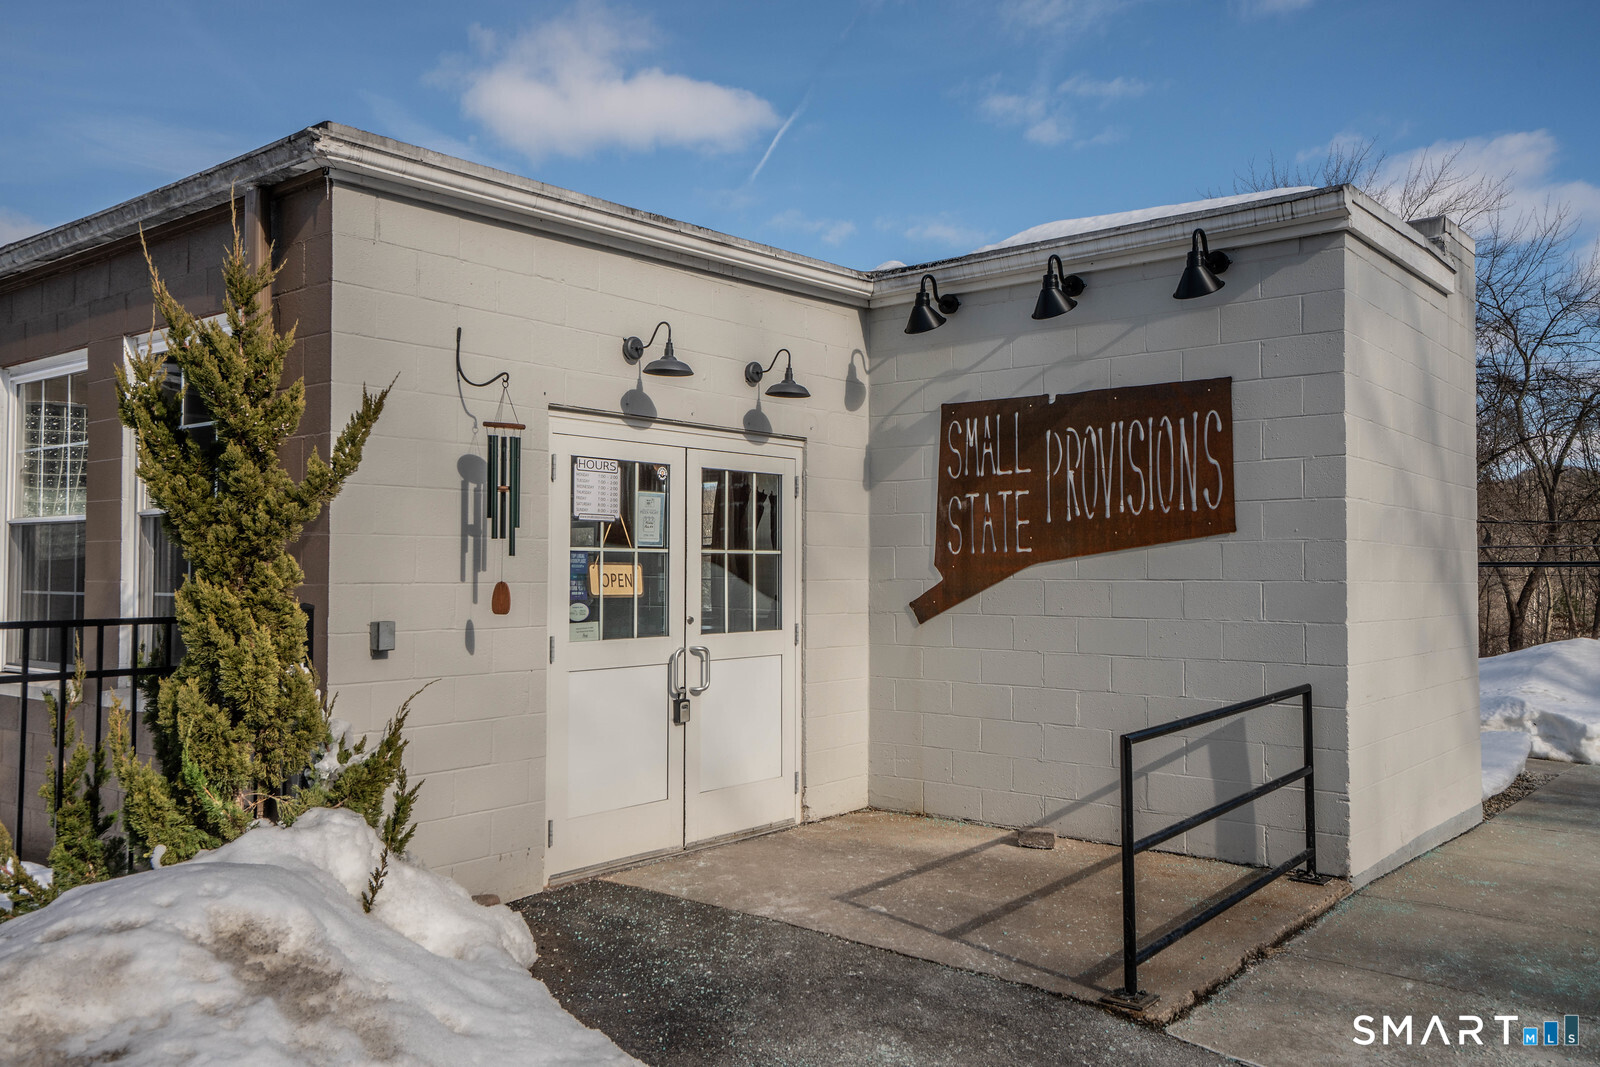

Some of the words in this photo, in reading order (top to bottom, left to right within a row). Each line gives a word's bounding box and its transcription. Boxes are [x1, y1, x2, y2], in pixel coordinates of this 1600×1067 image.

[578, 458, 617, 471] HOURS
[947, 411, 1032, 479] SMALL
[1046, 409, 1223, 524] PROVISIONS
[947, 490, 1032, 555] STATE
[602, 573, 632, 588] OPEN
